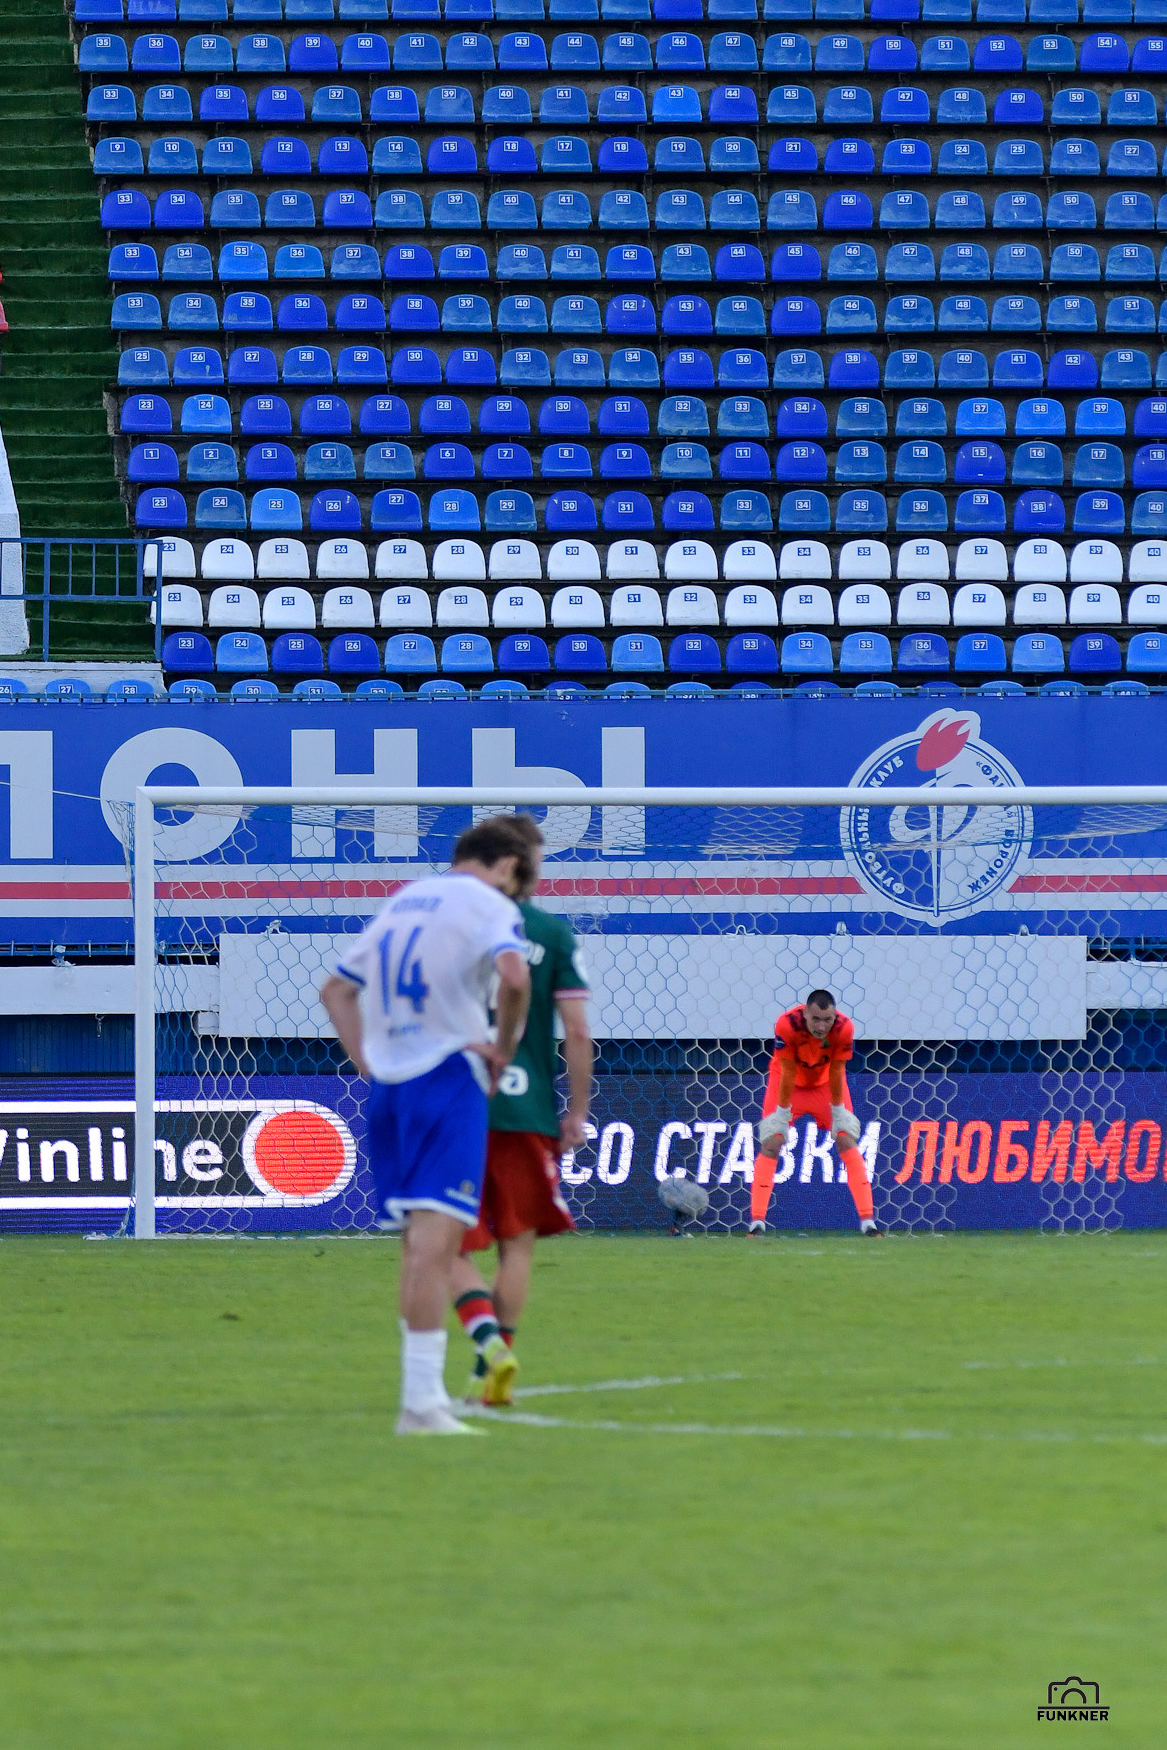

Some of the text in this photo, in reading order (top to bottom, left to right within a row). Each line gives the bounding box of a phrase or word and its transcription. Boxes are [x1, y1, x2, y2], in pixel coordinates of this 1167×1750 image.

[869, 754, 904, 789] КЛУБ
[378, 925, 430, 1015] 14
[561, 1121, 635, 1185] СО
[894, 1119, 1167, 1184] ЛЮБИМО
